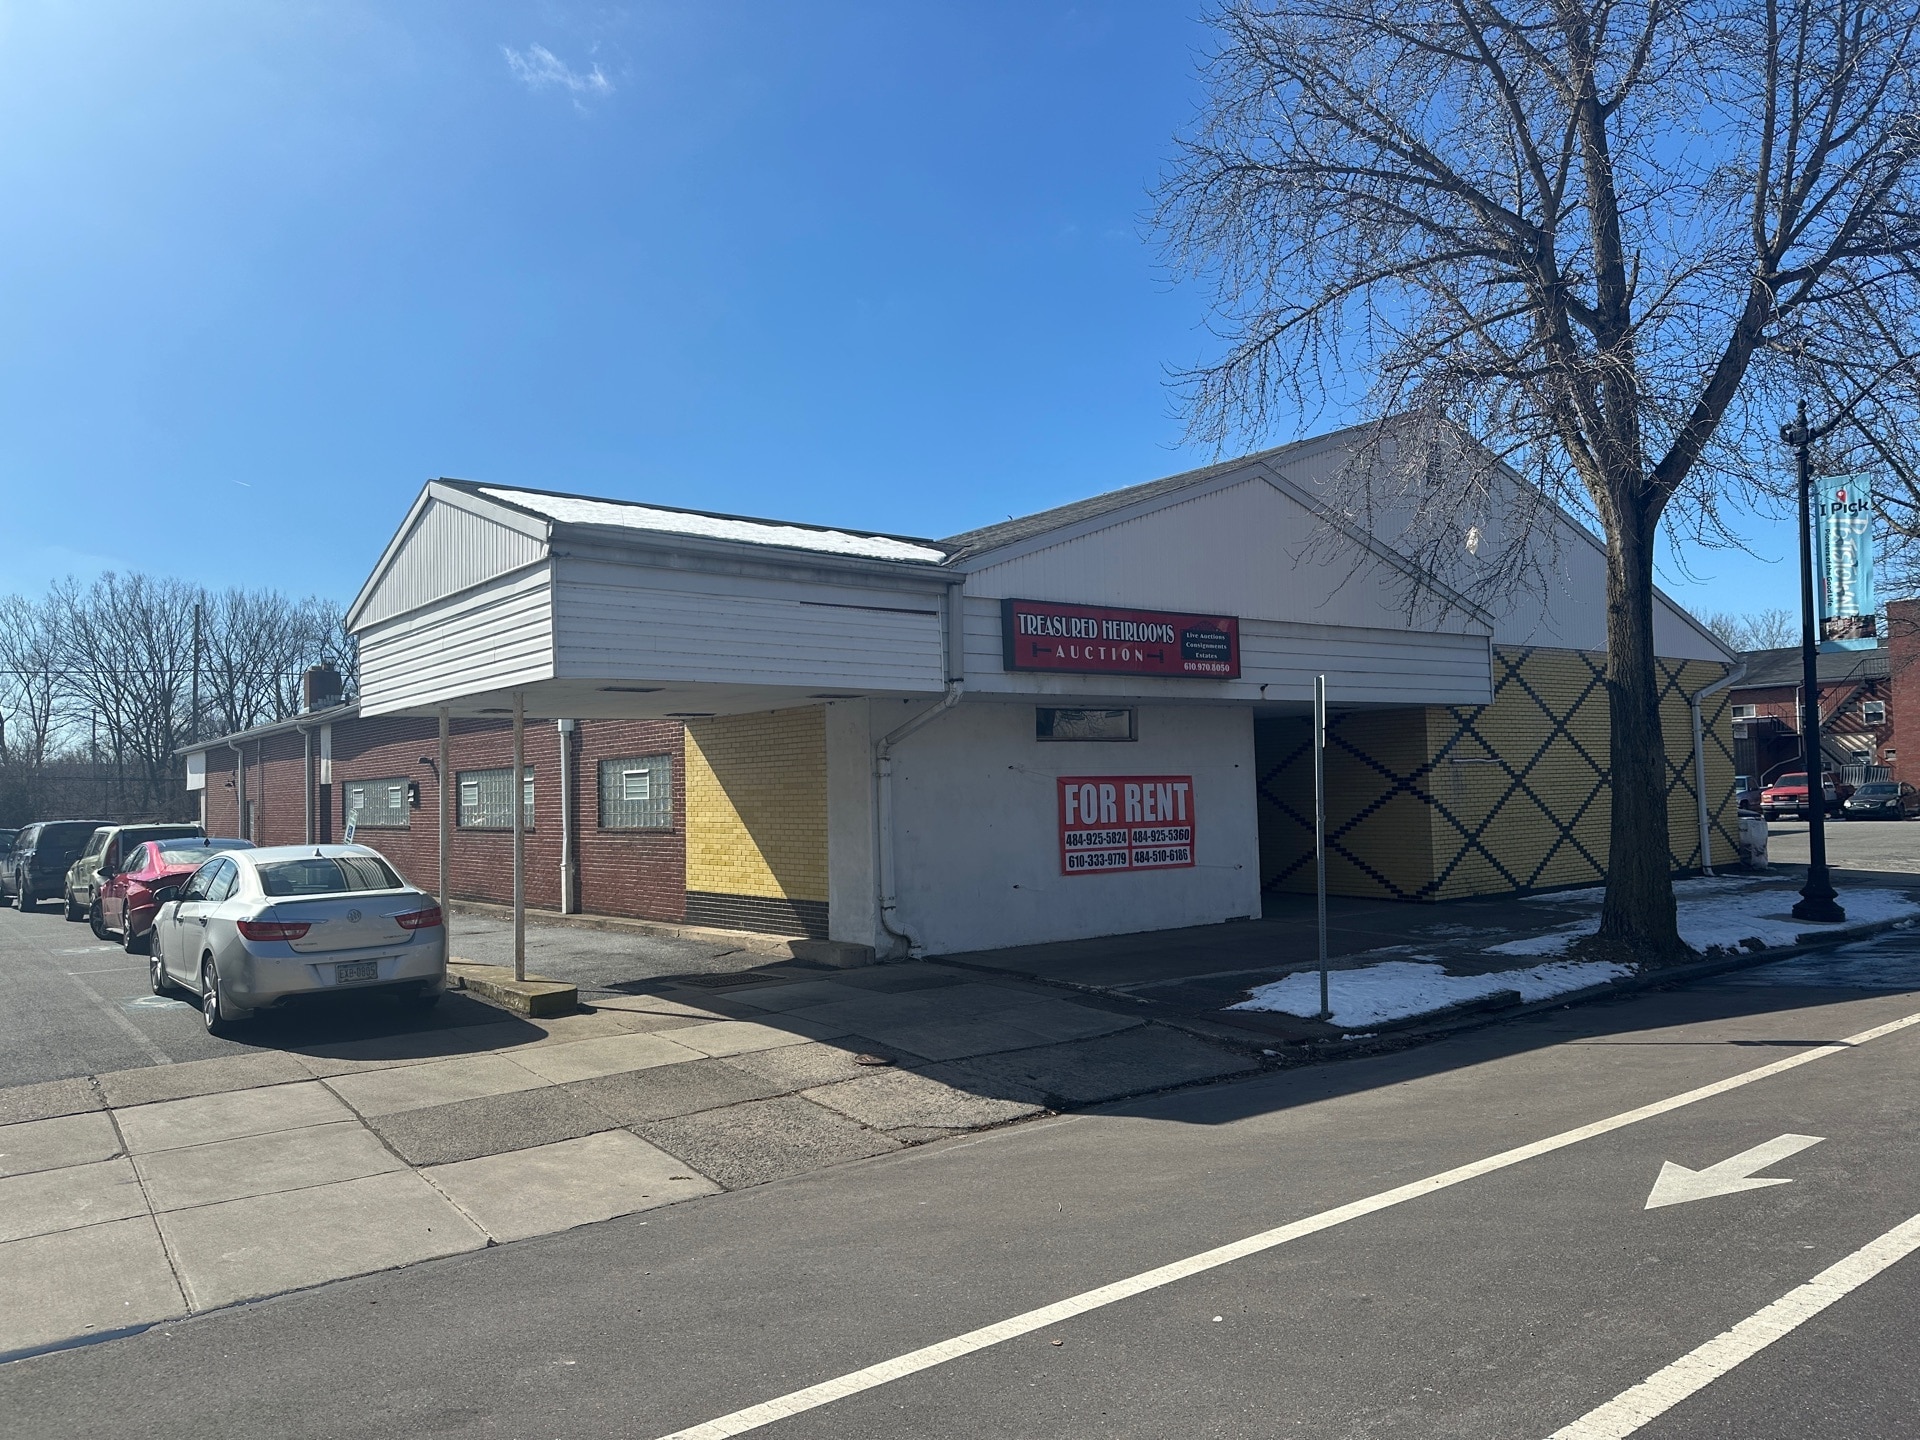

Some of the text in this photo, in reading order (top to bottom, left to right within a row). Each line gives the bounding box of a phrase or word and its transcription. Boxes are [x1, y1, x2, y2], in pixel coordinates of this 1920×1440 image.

[1820, 498, 1869, 517] I Pick
[1017, 613, 1175, 643] TREASURED HEIRLOOMS
[1055, 645, 1144, 661] AUCTION
[1185, 641, 1227, 650] Consignments
[1183, 662, 1230, 672] 610.970.8050
[1065, 783, 1189, 825] FOR RENT
[1065, 831, 1127, 846] 484-925-5824
[1132, 828, 1190, 843] 484-925-5360
[1068, 852, 1127, 868] 610-333-9779
[1134, 848, 1188, 863] 484-510-6186
